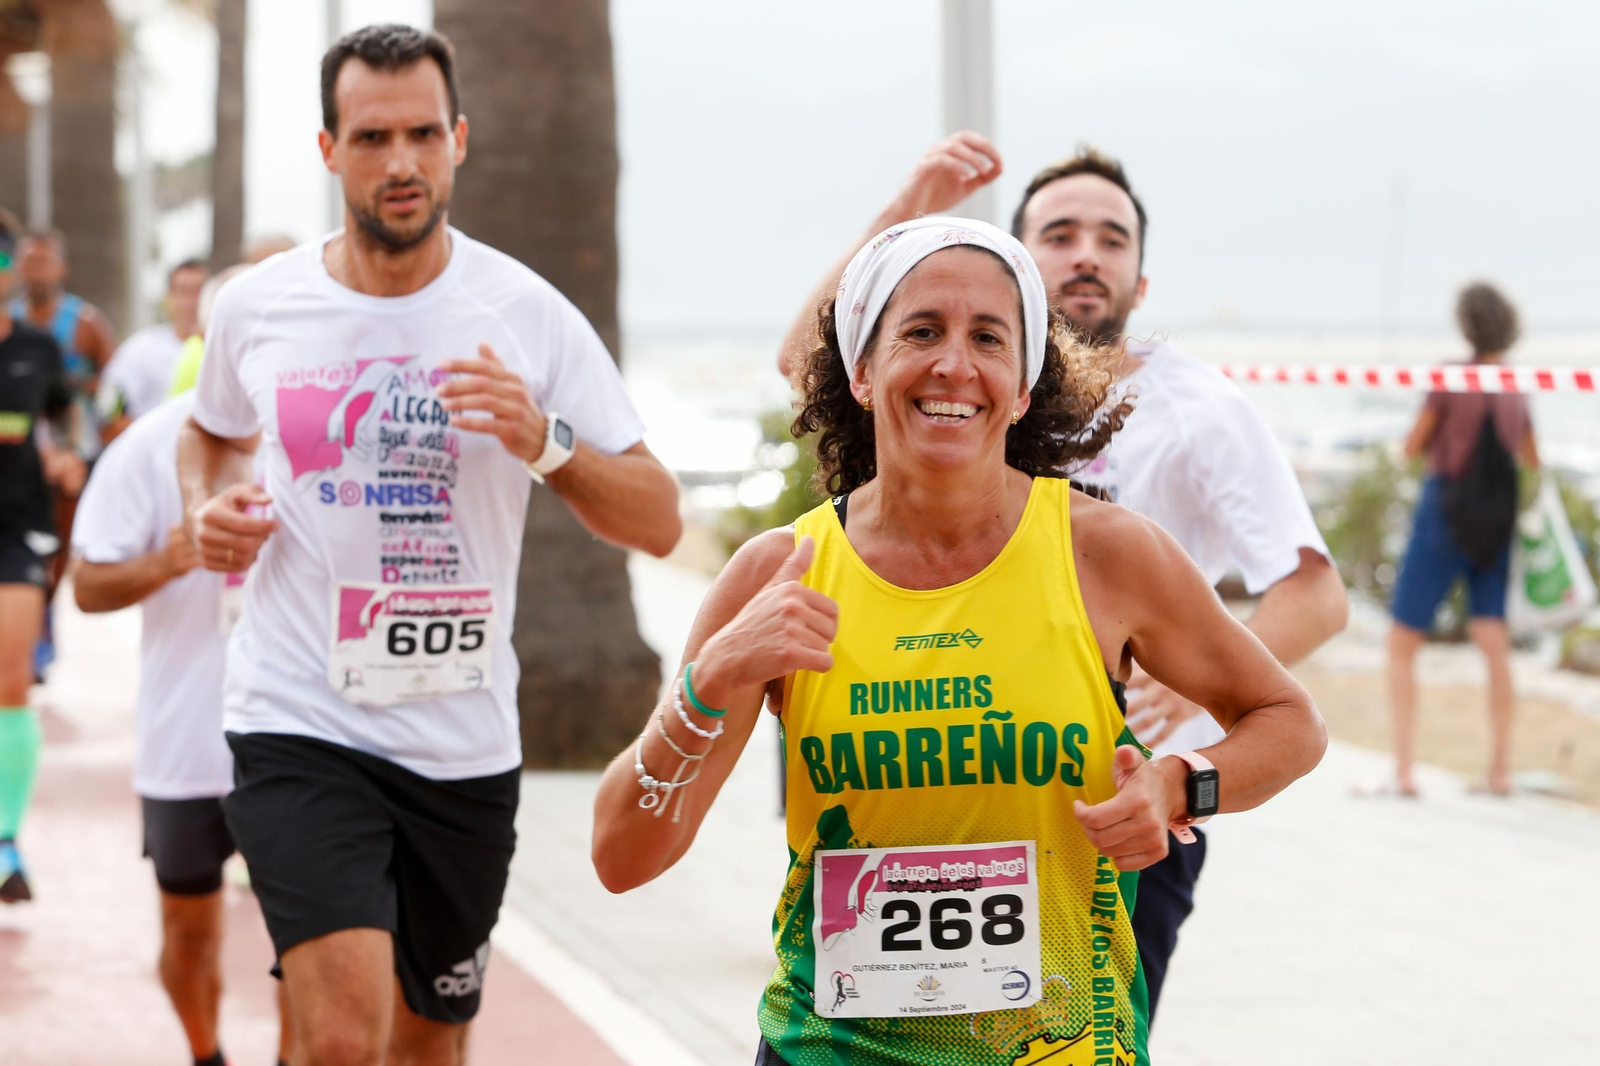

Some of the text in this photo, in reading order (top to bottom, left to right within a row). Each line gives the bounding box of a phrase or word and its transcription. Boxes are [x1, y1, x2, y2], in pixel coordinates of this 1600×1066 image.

[320, 480, 452, 507] SONRISA
[387, 618, 486, 656] 605
[894, 631, 961, 651] PENTEX
[850, 675, 993, 715] RUNNERS
[801, 710, 1089, 794] BARREÑOS
[977, 858, 1026, 878] valores
[1091, 891, 1118, 922] DE
[881, 894, 1025, 951] 268
[1091, 924, 1114, 970] LOS
[940, 961, 969, 970] MARIA
[899, 1003, 967, 1014] 14 Septiembre 2024
